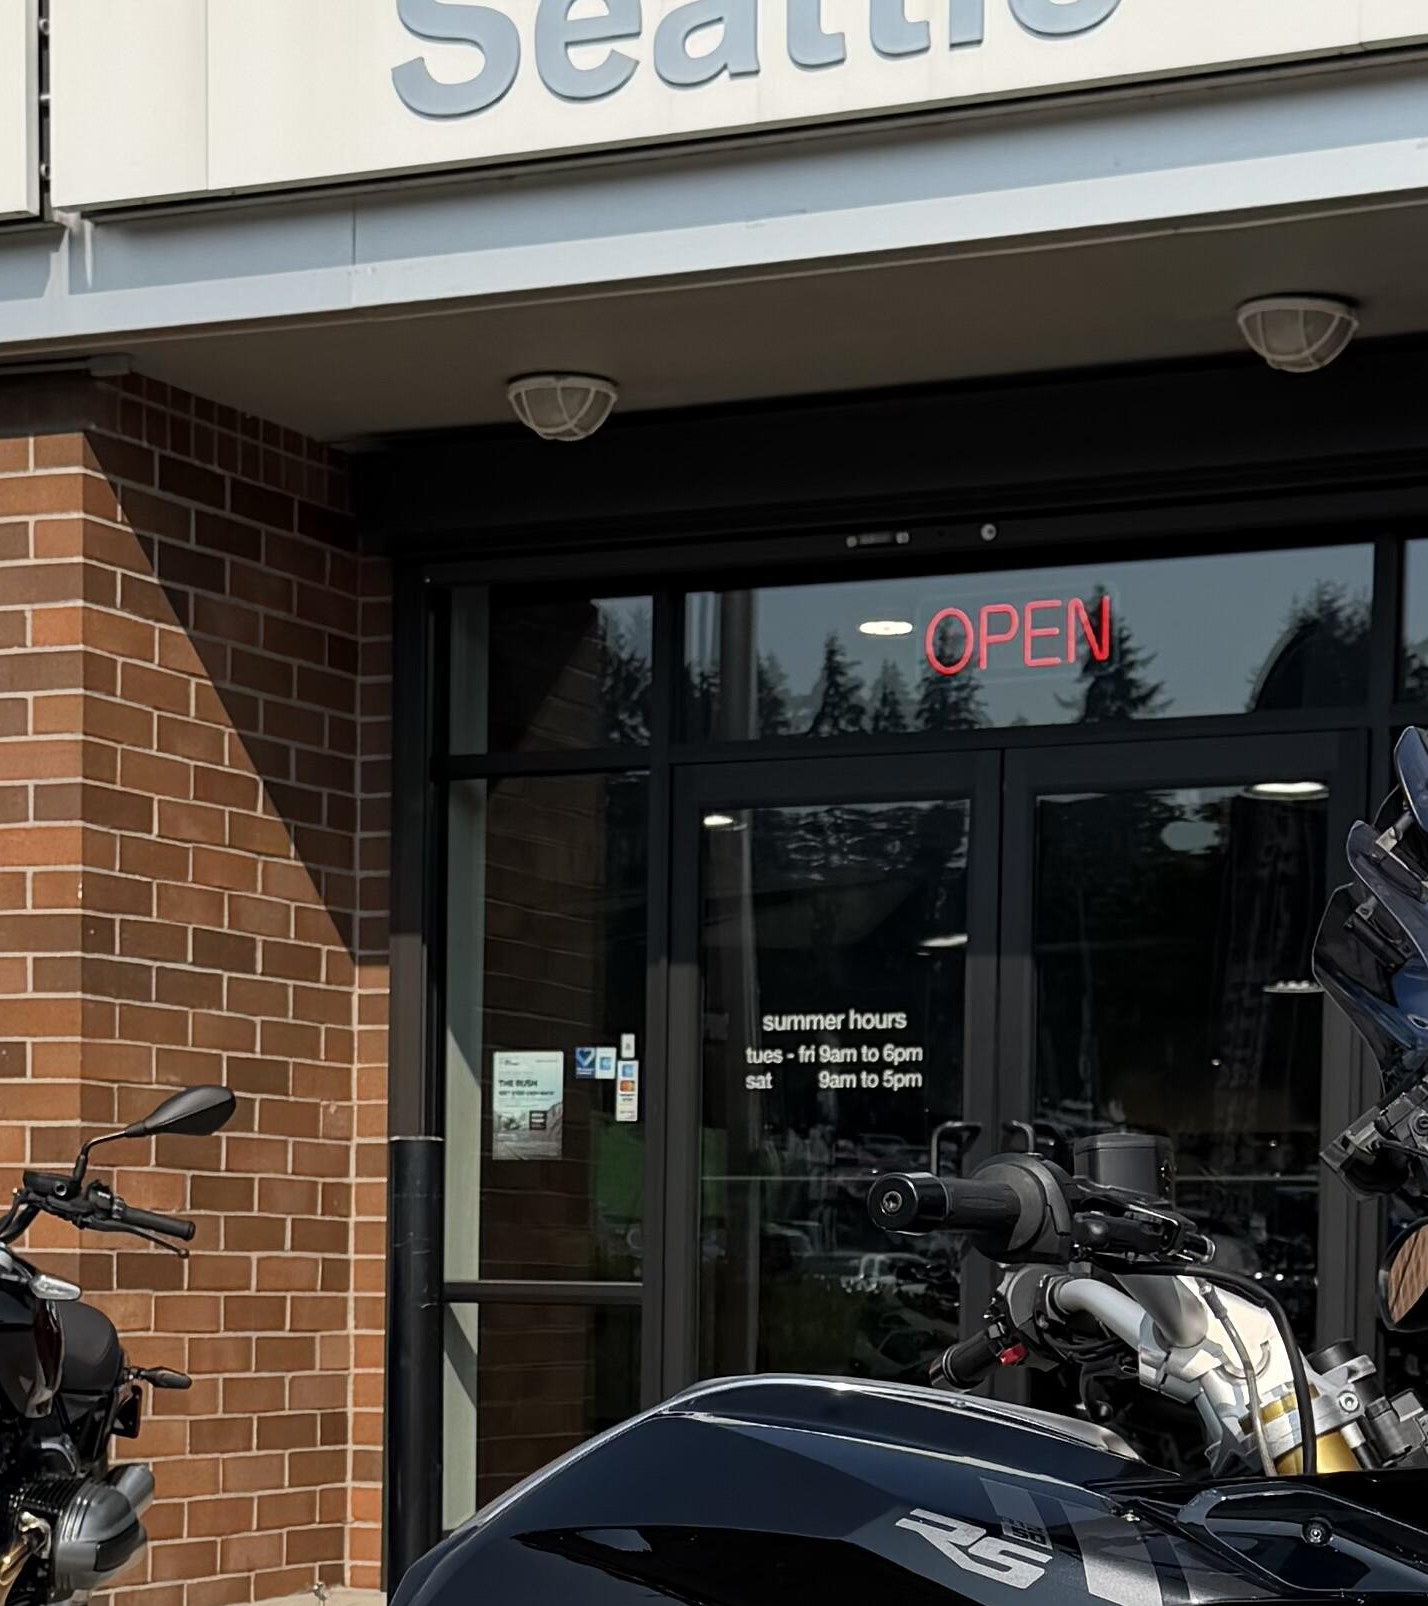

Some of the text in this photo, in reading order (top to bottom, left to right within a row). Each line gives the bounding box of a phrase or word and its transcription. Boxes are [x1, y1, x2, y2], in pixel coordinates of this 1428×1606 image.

[925, 596, 1110, 676] OPEN
[762, 1008, 908, 1032] summer hours
[745, 1046, 784, 1064] tues
[798, 1044, 816, 1063] fri
[818, 1044, 858, 1063] 9am
[861, 1044, 880, 1062] to
[882, 1043, 924, 1066] 6pm
[745, 1069, 923, 1092] sat 9am to 5pm
[894, 1508, 1053, 1589] RS
